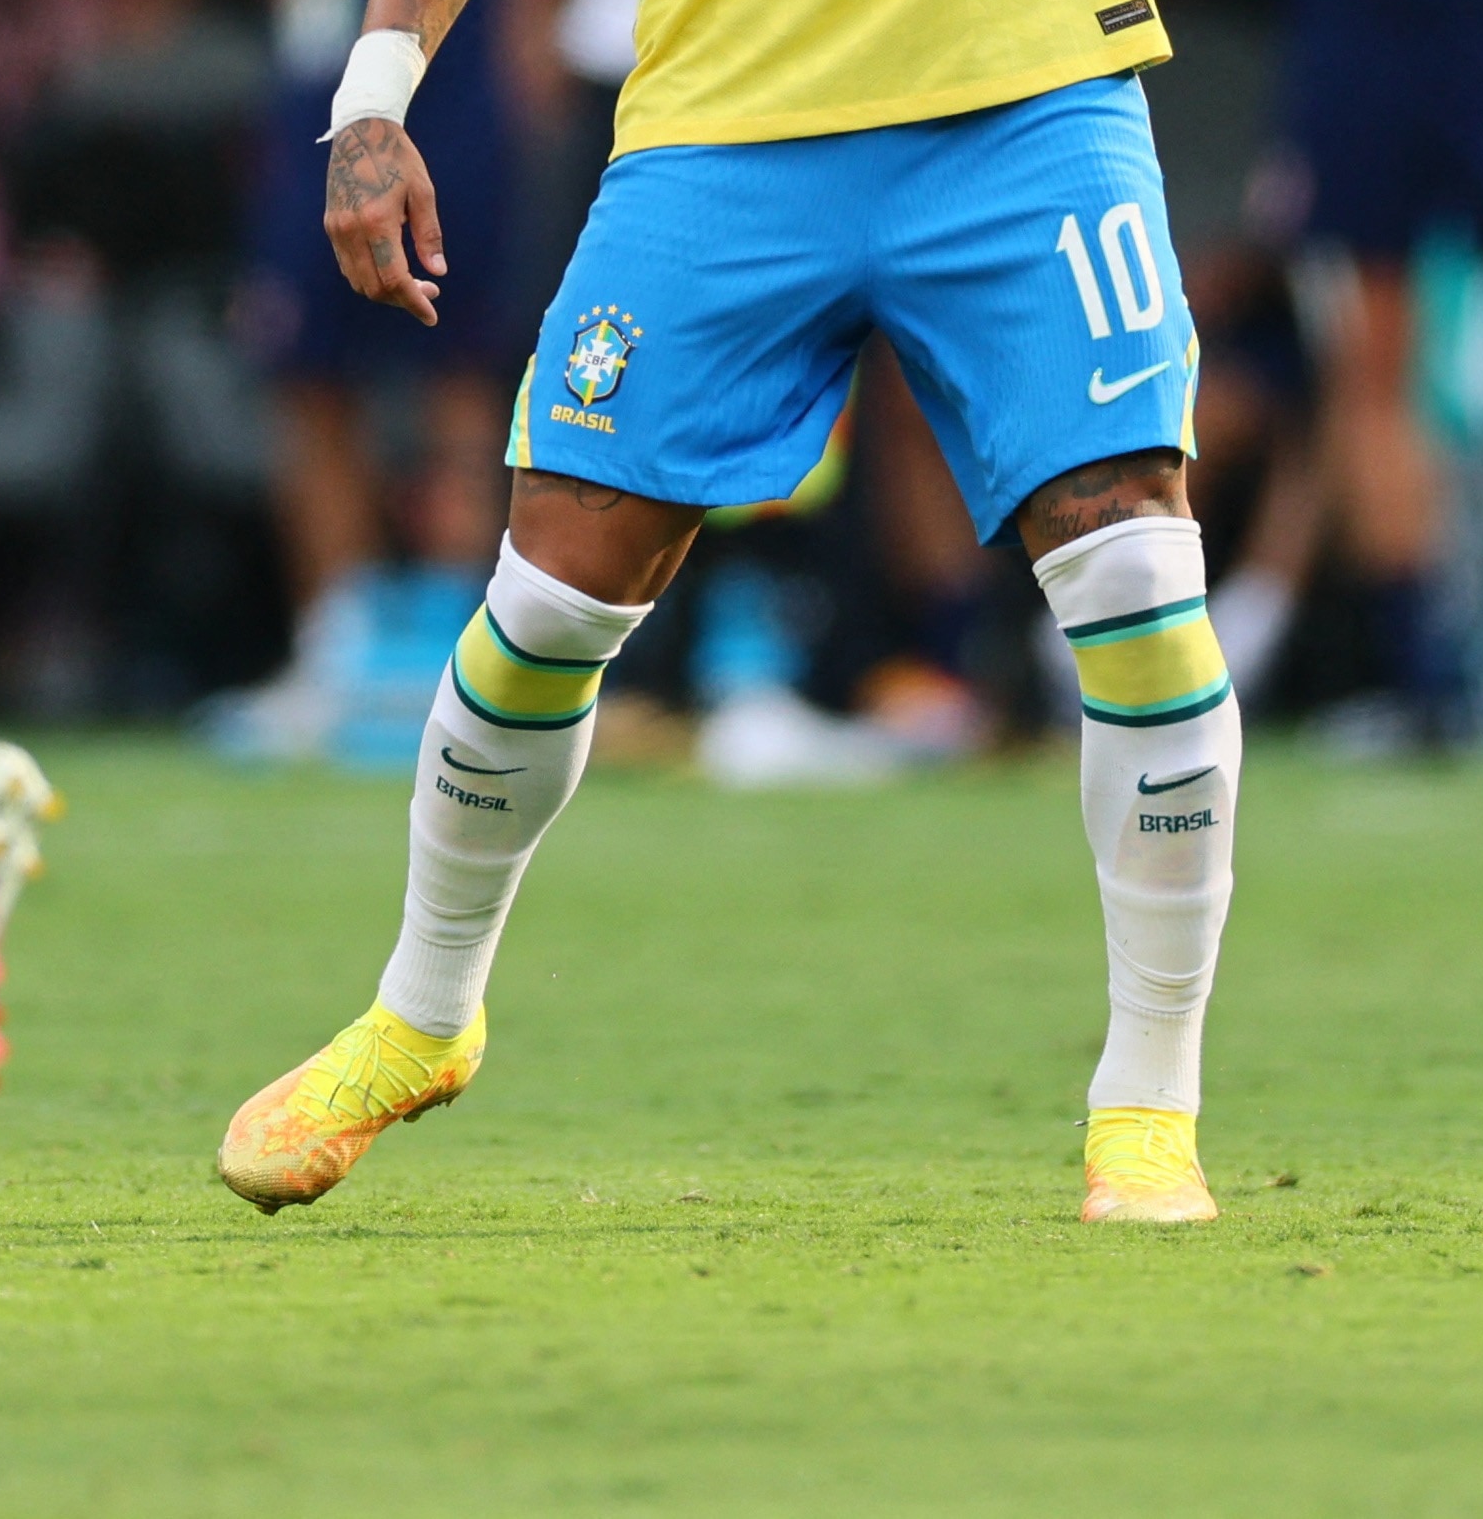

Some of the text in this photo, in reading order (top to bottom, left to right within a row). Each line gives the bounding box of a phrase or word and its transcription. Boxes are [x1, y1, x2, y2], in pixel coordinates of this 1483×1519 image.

[1055, 202, 1165, 340] 10
[584, 353, 609, 367] CBF
[550, 404, 616, 434] BRASIL
[436, 775, 513, 812] BRASIL
[1139, 808, 1219, 833] BRASIL
